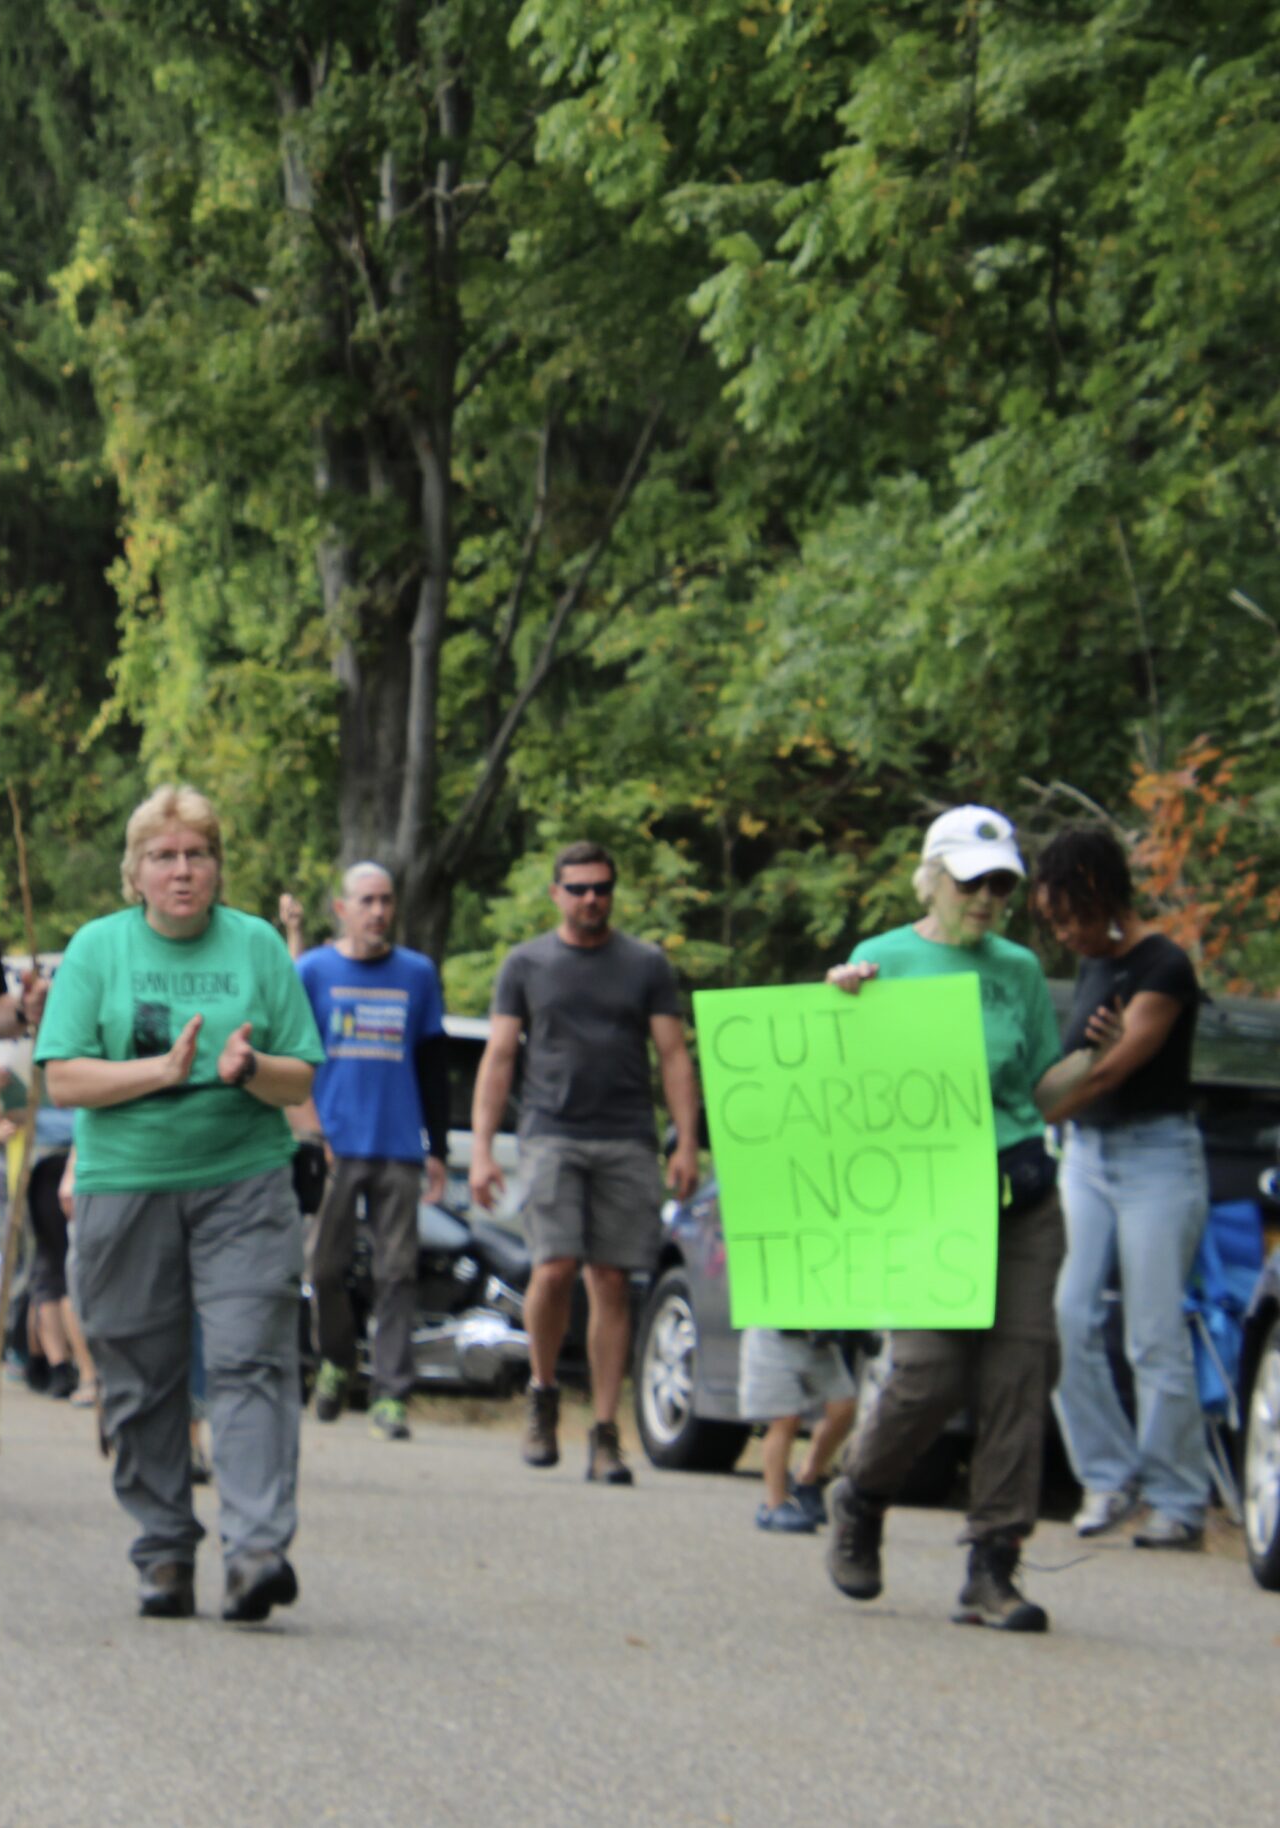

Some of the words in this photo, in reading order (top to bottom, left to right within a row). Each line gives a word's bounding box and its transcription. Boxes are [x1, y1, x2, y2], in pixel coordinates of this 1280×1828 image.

[711, 1007, 856, 1074] CUT
[720, 1068, 984, 1146] CARBON
[788, 1143, 960, 1222] NOT
[729, 1227, 980, 1311] TREES
